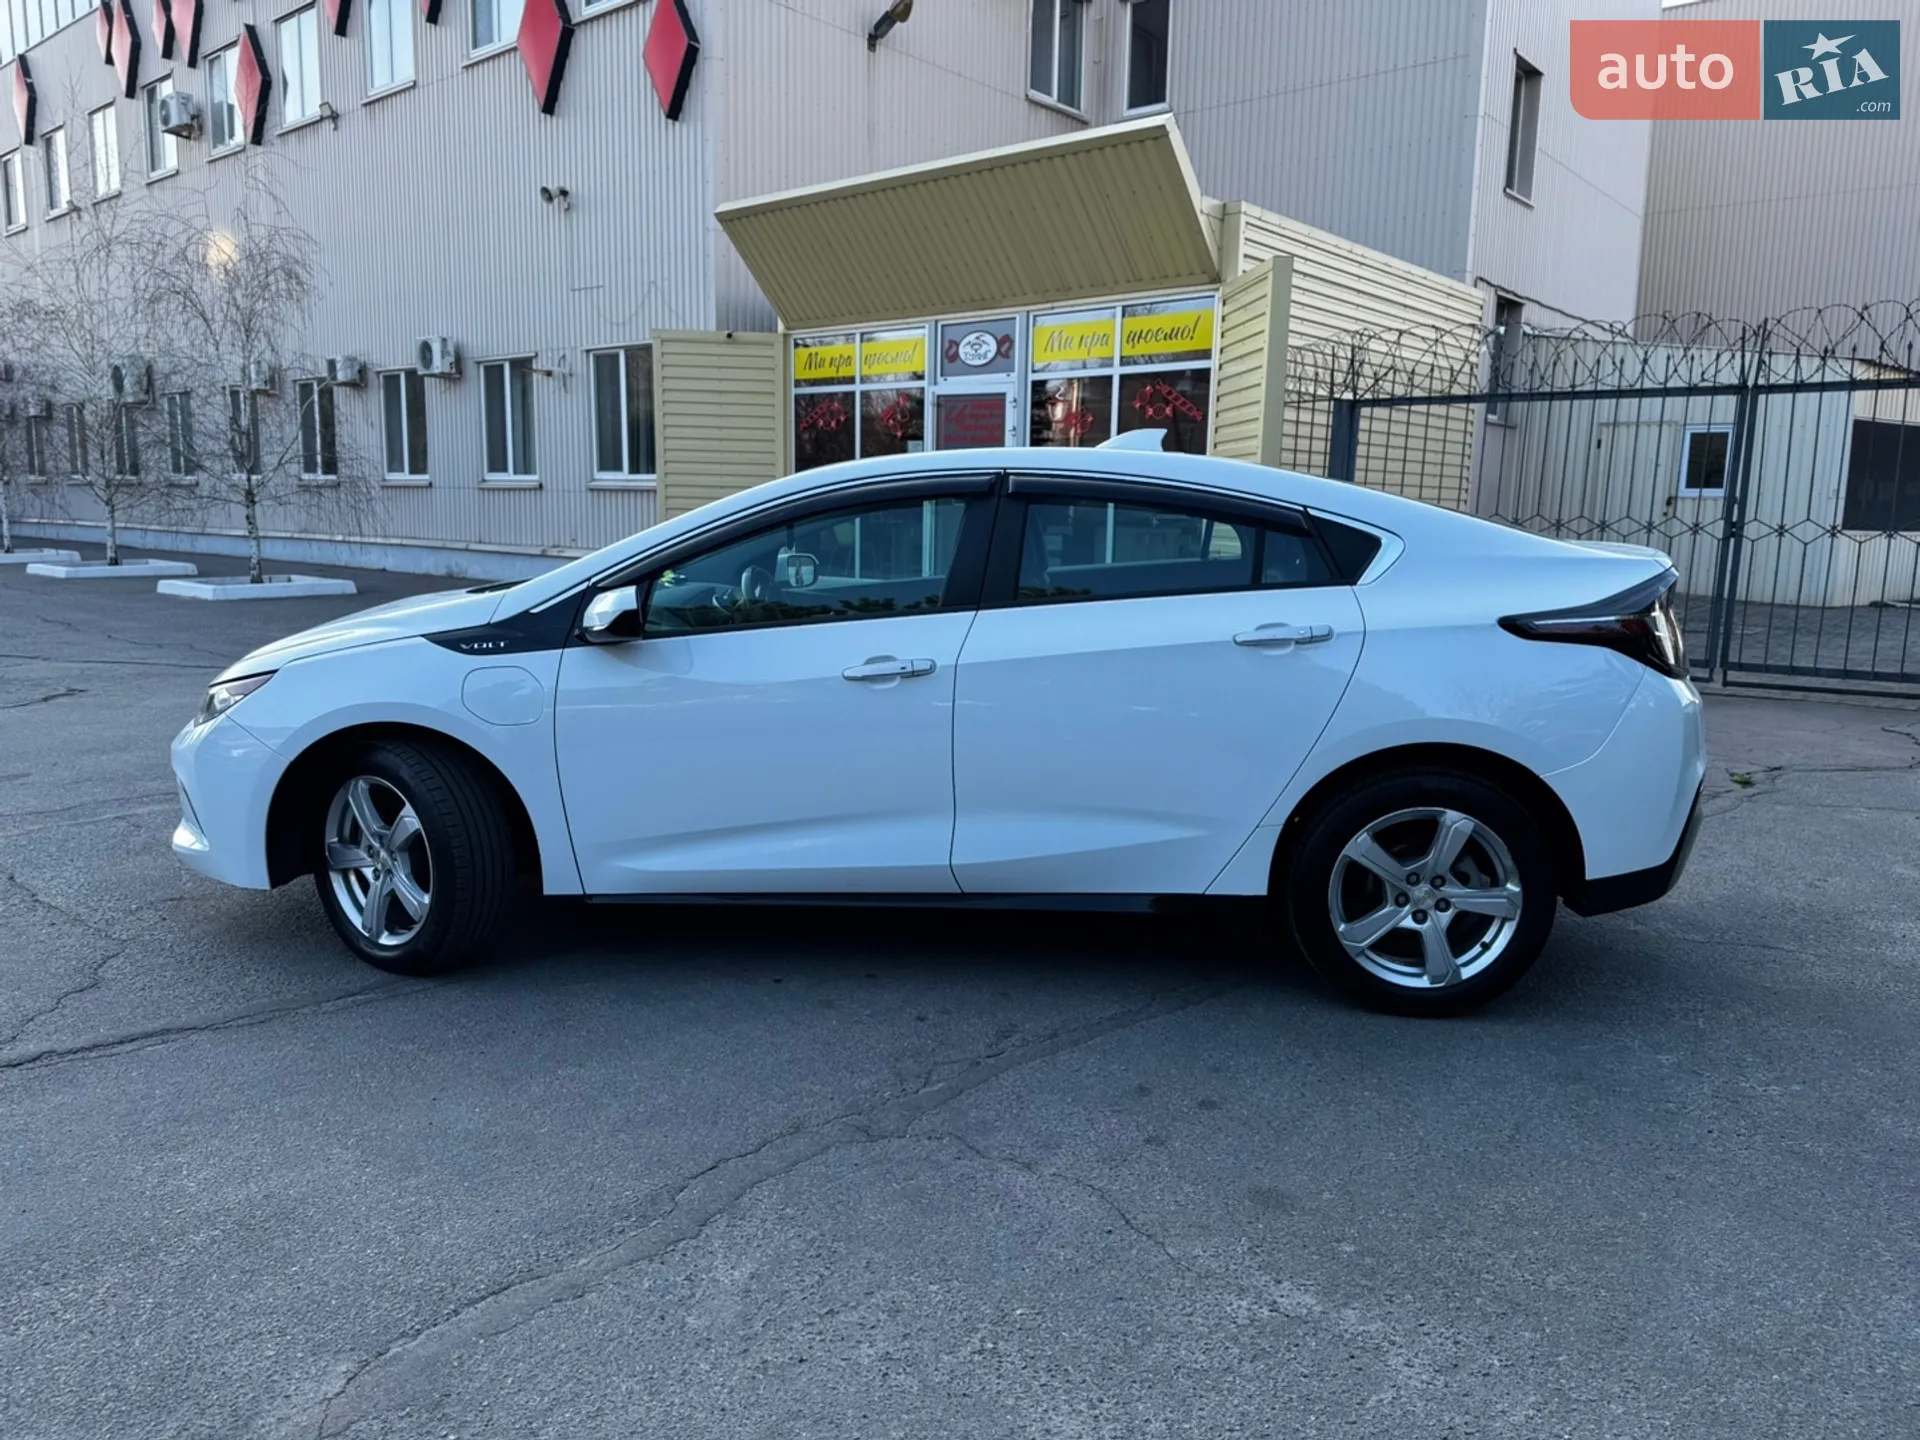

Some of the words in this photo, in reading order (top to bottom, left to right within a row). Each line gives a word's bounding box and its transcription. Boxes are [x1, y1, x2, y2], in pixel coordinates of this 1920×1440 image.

[1043, 330, 1073, 353] Ми
[803, 351, 827, 371] Ми
[460, 641, 509, 649] VOLT
